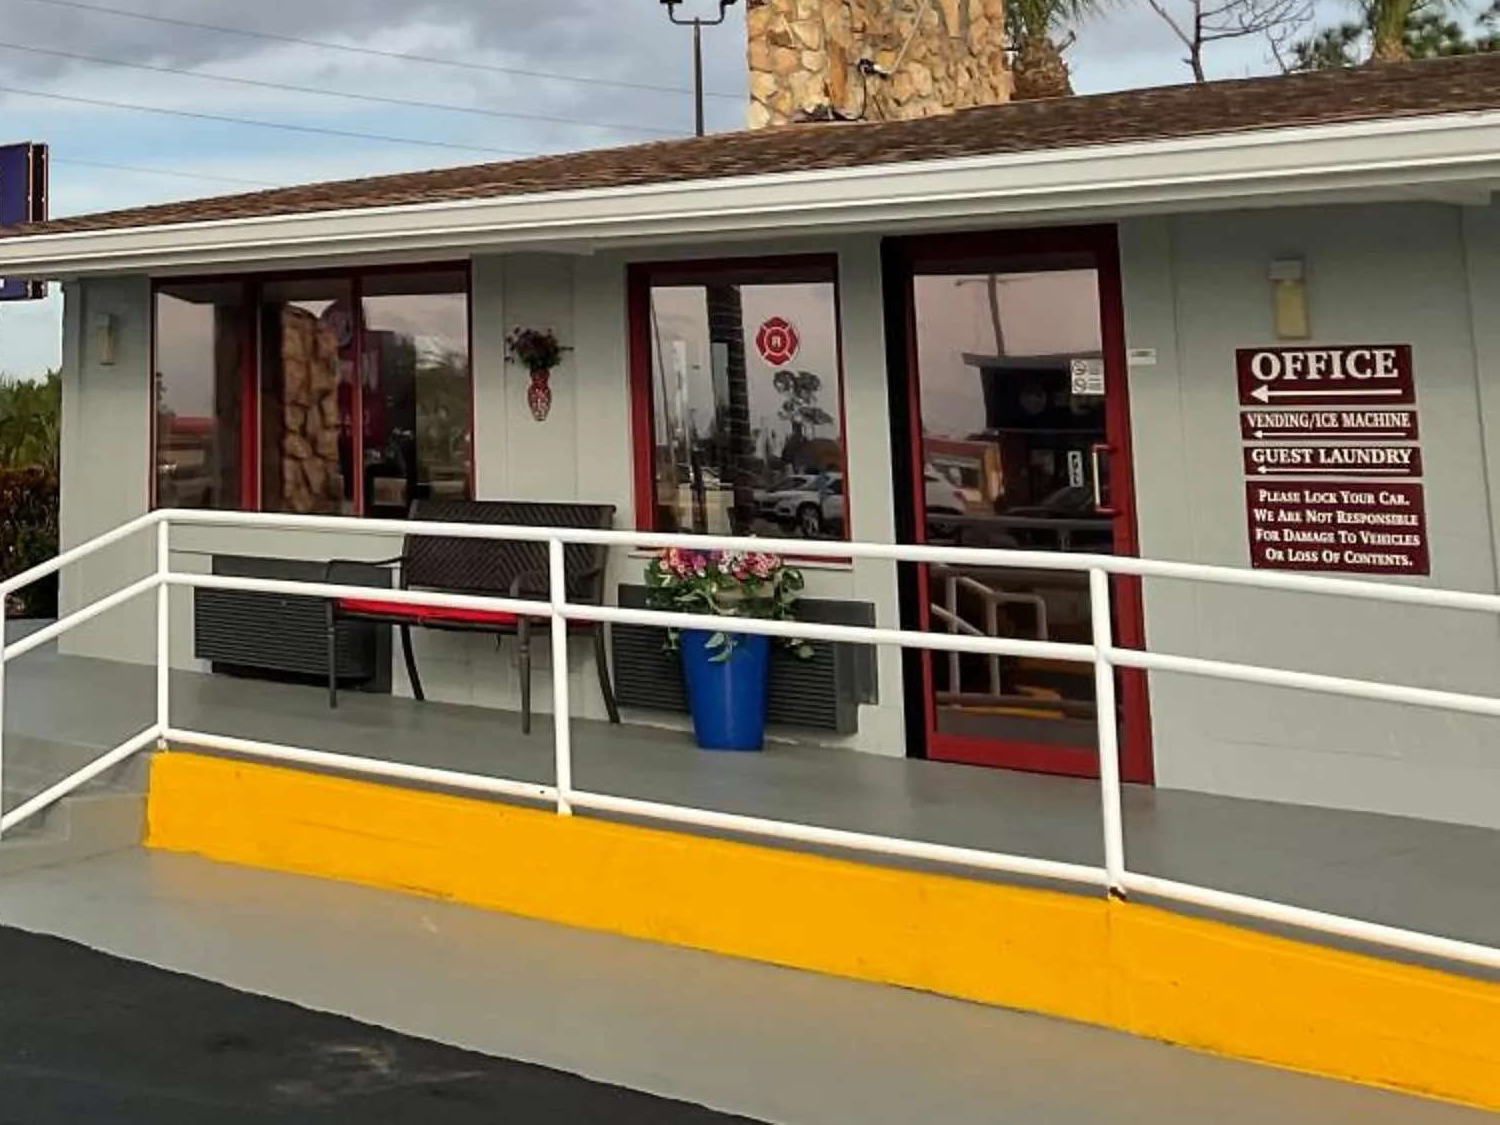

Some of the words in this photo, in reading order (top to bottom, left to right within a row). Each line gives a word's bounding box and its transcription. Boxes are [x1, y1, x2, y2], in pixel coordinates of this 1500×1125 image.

[1251, 349, 1399, 381] OFFICE
[1247, 412, 1339, 430] VENDING/ICE
[1342, 412, 1411, 428] MACHINE
[1251, 448, 1314, 464] GUEST
[1318, 448, 1413, 464] LAUNDRY
[1258, 488, 1300, 503] PLEASE
[1304, 490, 1338, 504] LOCK
[1339, 490, 1377, 505] YOUR
[1379, 491, 1411, 506] CAR.
[1253, 508, 1275, 522] WE
[1277, 509, 1302, 523] ARE
[1305, 510, 1334, 524] NOT
[1336, 510, 1419, 526] RESPONSIBLE
[1255, 528, 1281, 542] FOR
[1283, 529, 1335, 543] DAMAGE
[1337, 531, 1357, 544] TO
[1359, 531, 1421, 546] VEHICLES
[1265, 548, 1285, 561] OR
[1288, 548, 1319, 562] LOSS
[1322, 549, 1340, 563] OF
[1344, 551, 1414, 566] CONTENTS.
